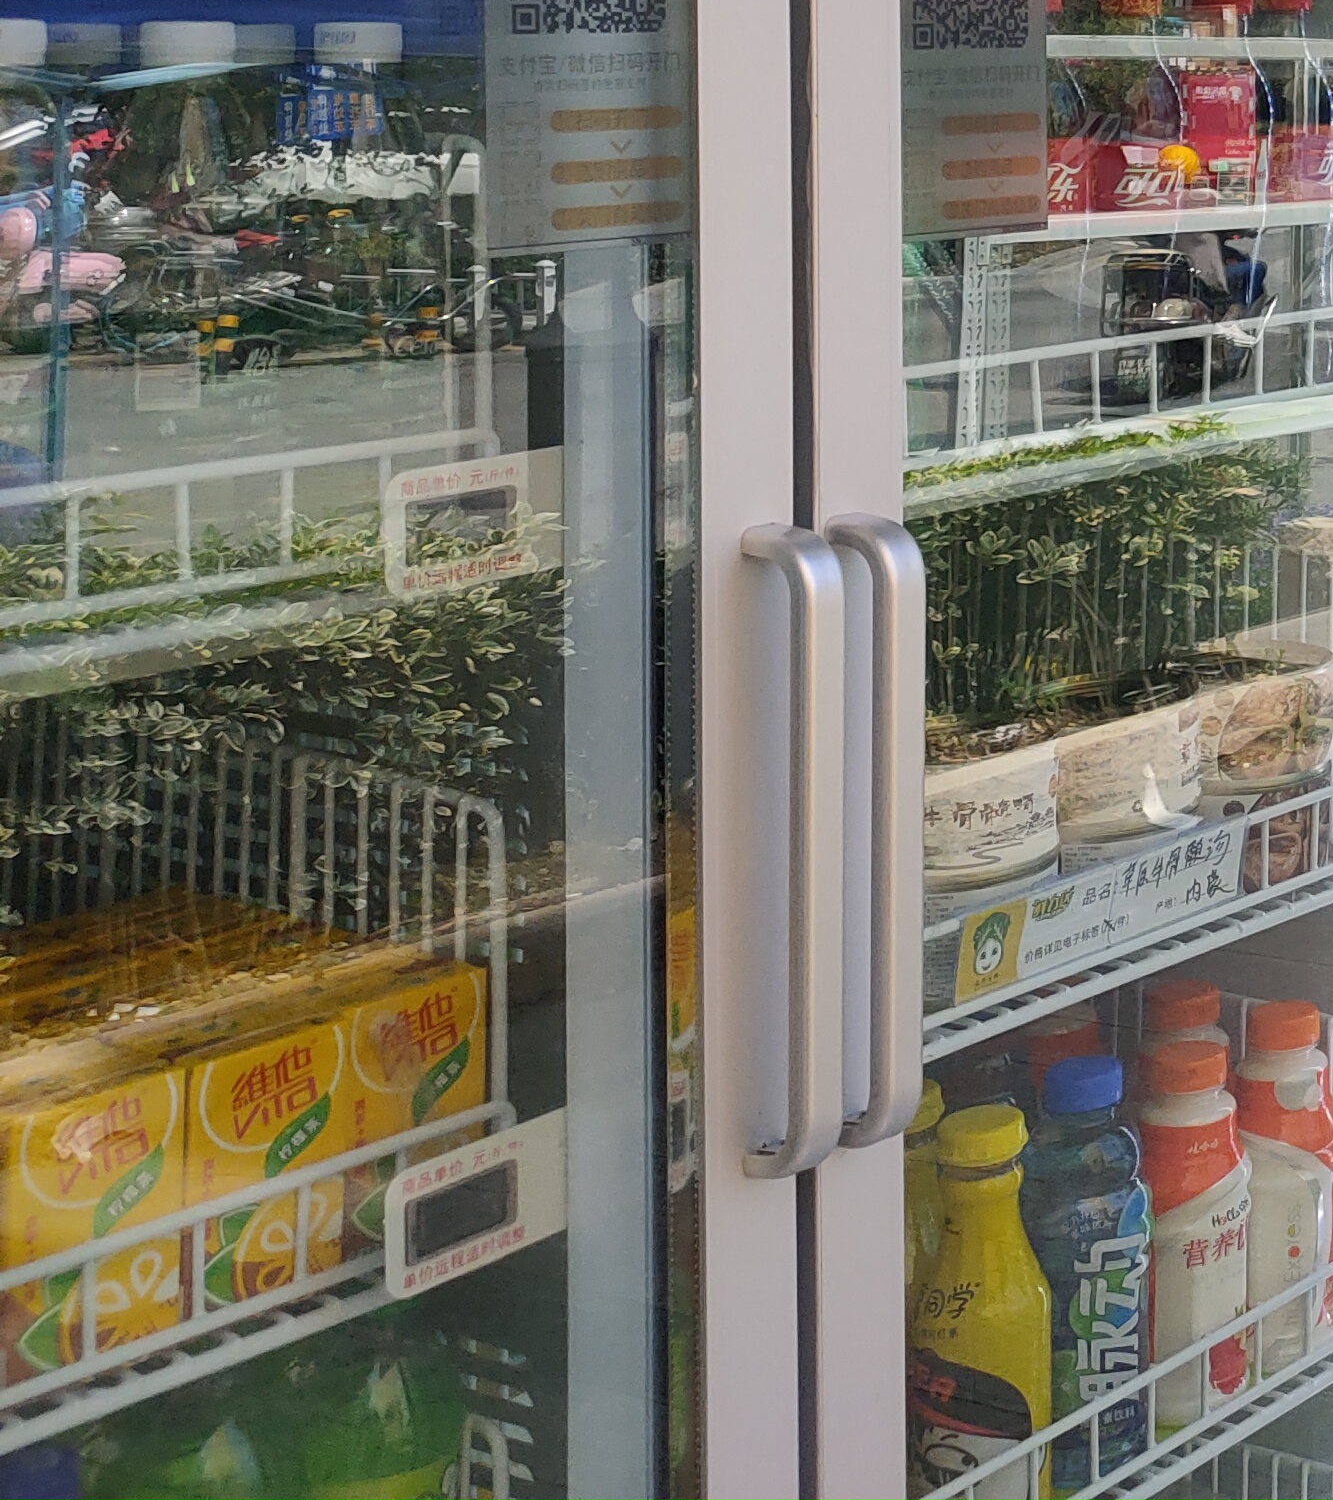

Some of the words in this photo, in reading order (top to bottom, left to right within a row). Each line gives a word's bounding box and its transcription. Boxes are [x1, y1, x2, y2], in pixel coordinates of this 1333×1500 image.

[498, 51, 681, 77] 支付宝/微信扫码开门
[400, 471, 461, 497] 商品单价
[401, 1158, 463, 1194] 商品单价
[1073, 1232, 1150, 1402] 脉动
